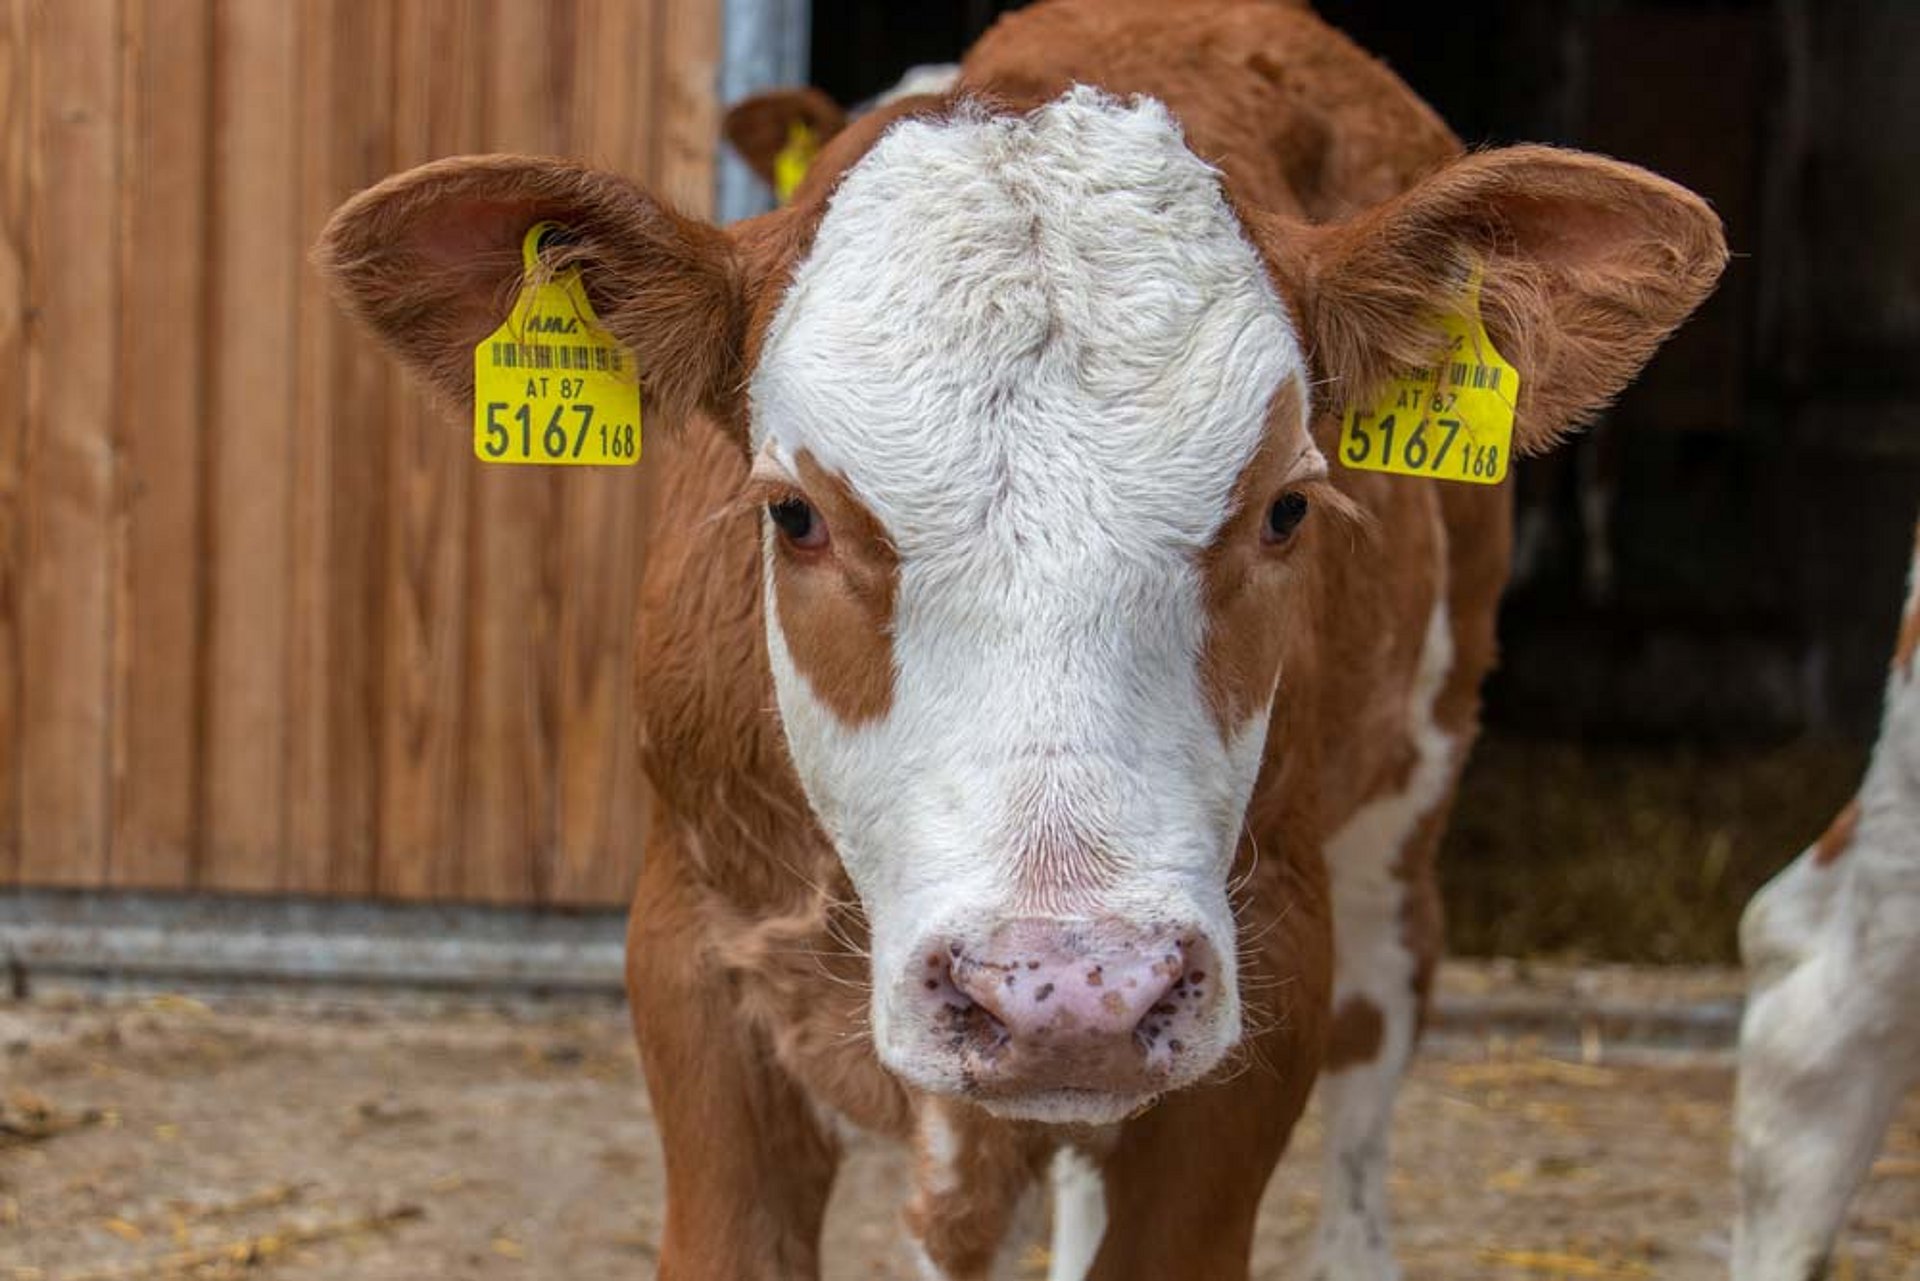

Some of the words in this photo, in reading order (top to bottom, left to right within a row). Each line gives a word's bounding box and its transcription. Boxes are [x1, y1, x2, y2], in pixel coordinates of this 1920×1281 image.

[526, 378, 549, 399] AT
[560, 378, 584, 399] 87
[1397, 389, 1422, 410] AT
[1432, 393, 1458, 413] 87
[485, 402, 594, 458] 5167
[600, 425, 635, 458] 168
[1347, 411, 1461, 471] 5167
[1463, 443, 1498, 477] 168
